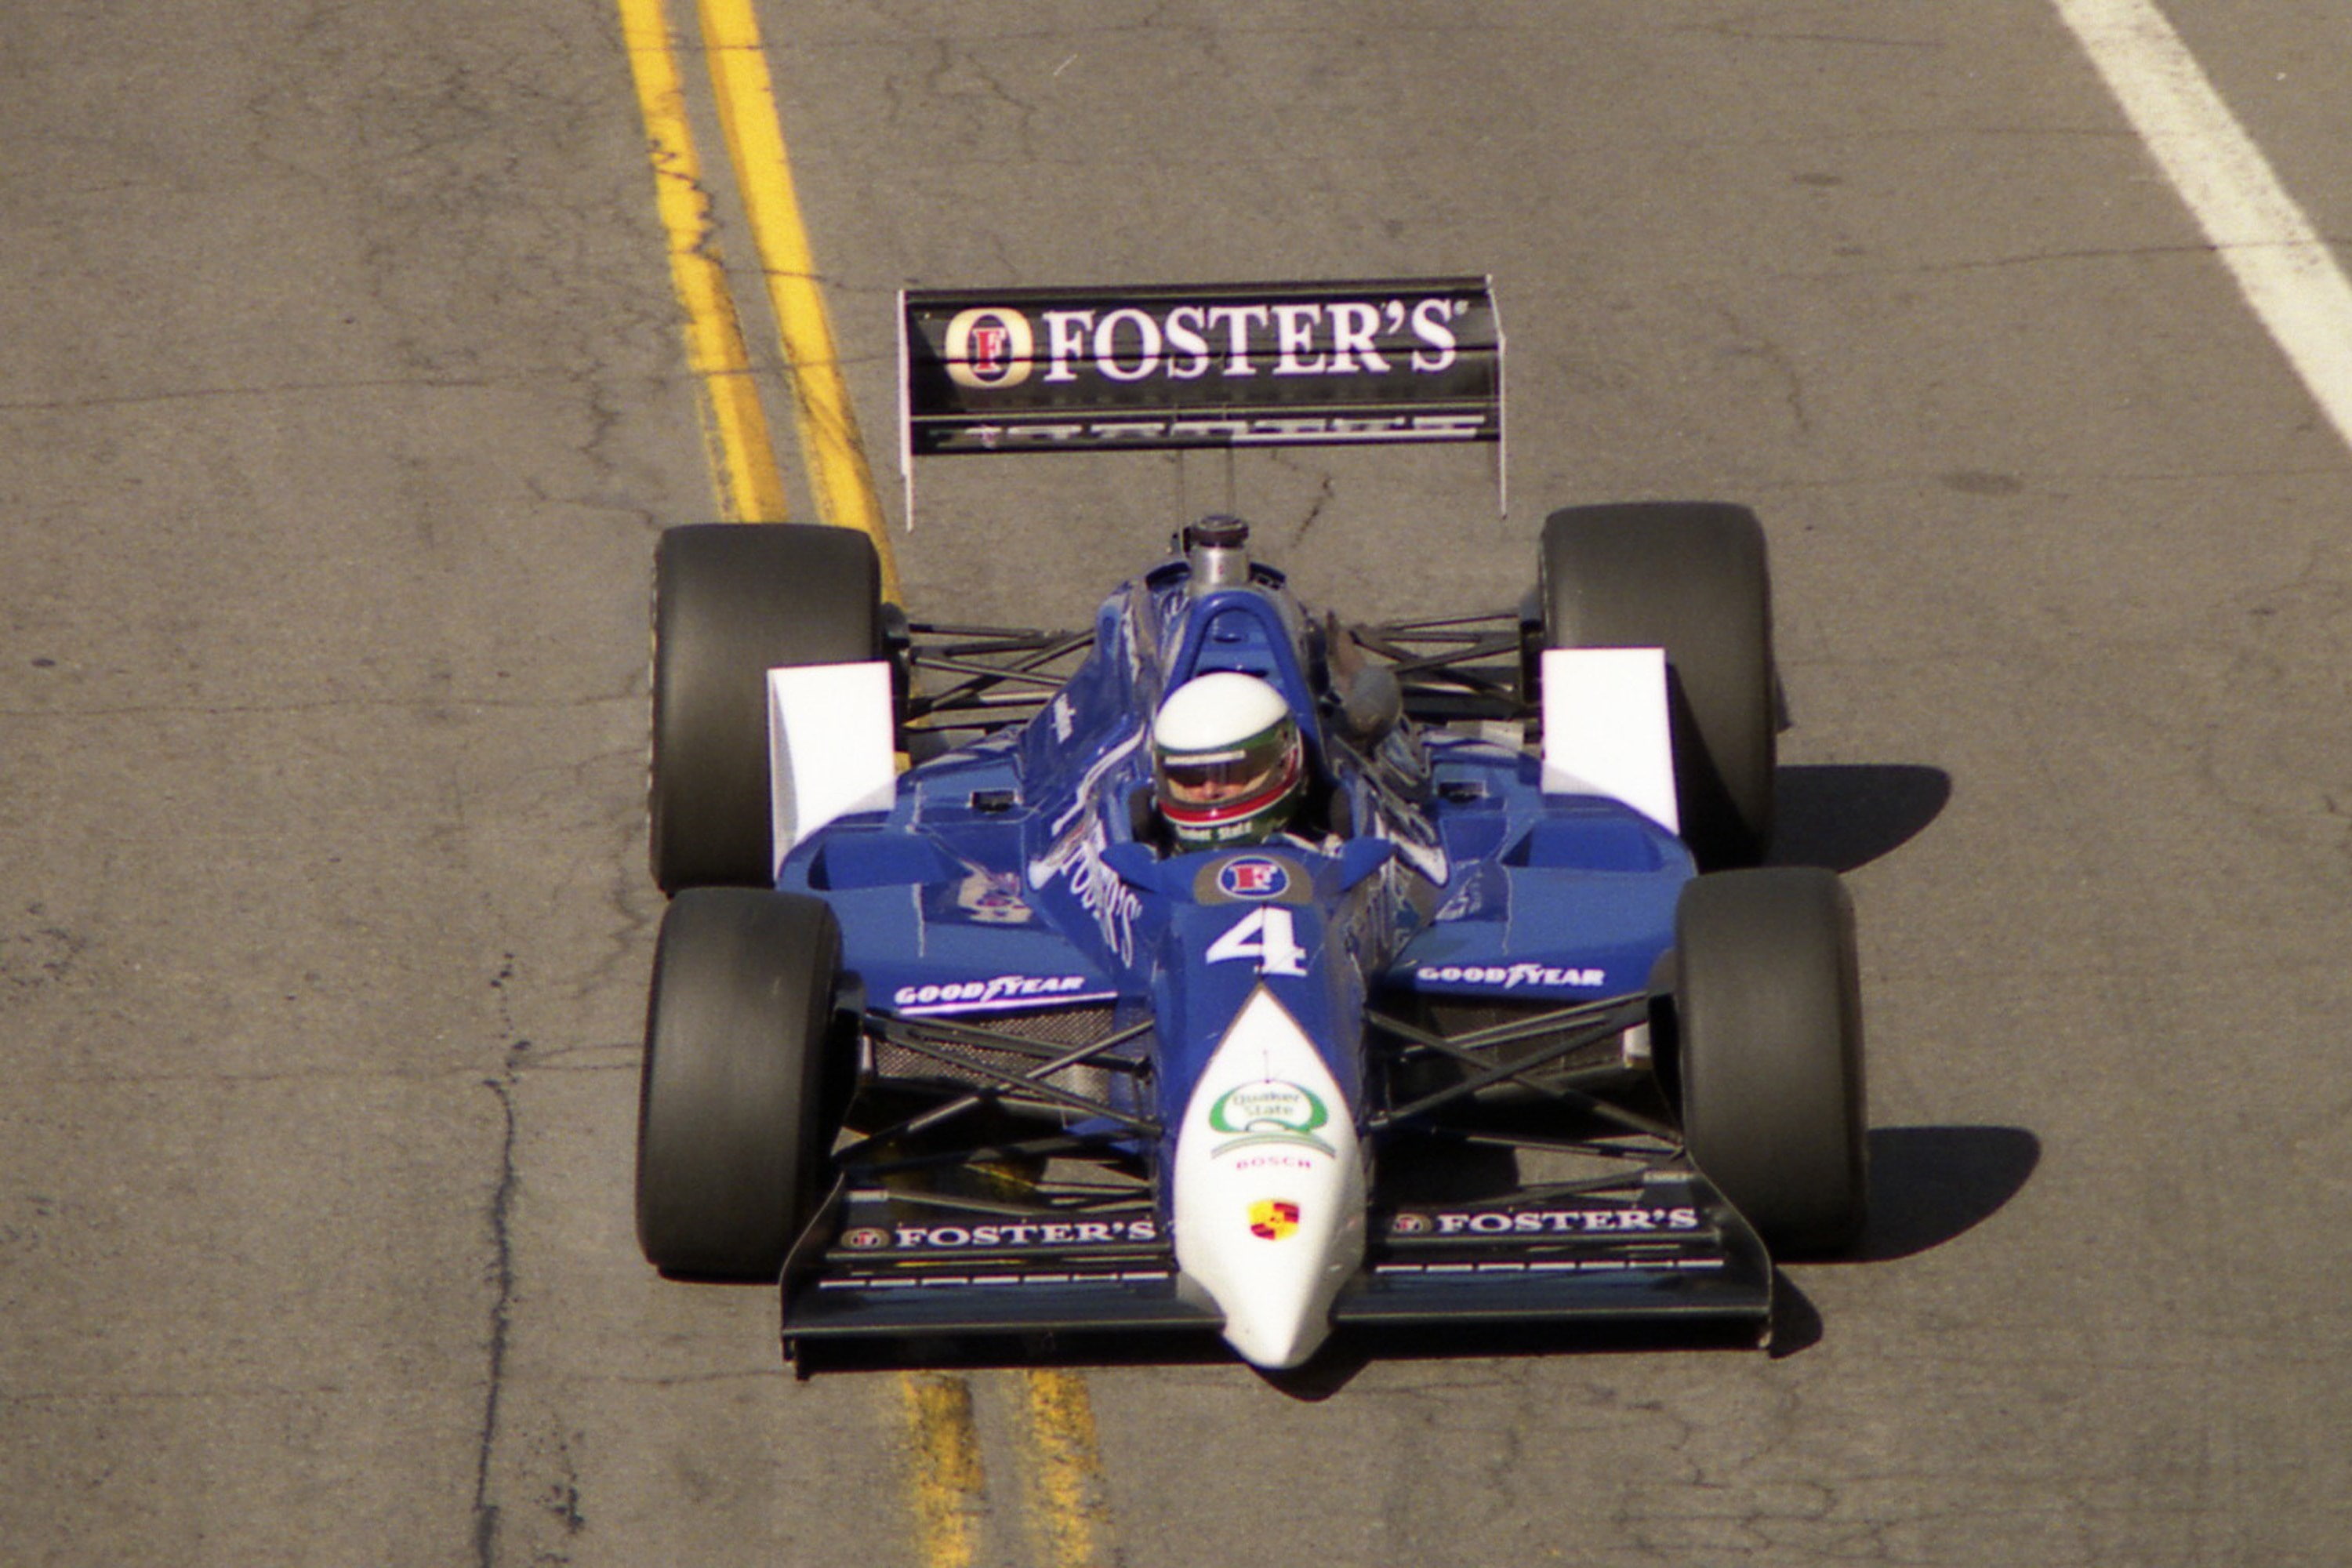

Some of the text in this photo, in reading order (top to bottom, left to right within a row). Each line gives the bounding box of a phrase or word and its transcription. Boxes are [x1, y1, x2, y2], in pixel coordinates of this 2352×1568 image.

[1042, 298, 1457, 382] FOSTER'S
[1206, 906, 1308, 976] 4
[894, 975, 1085, 1004] GOODYEAR
[1417, 963, 1606, 989] GOODYEAR
[895, 1221, 1157, 1247] FOSTER'S
[1436, 1207, 1699, 1234] FOSTER'S
